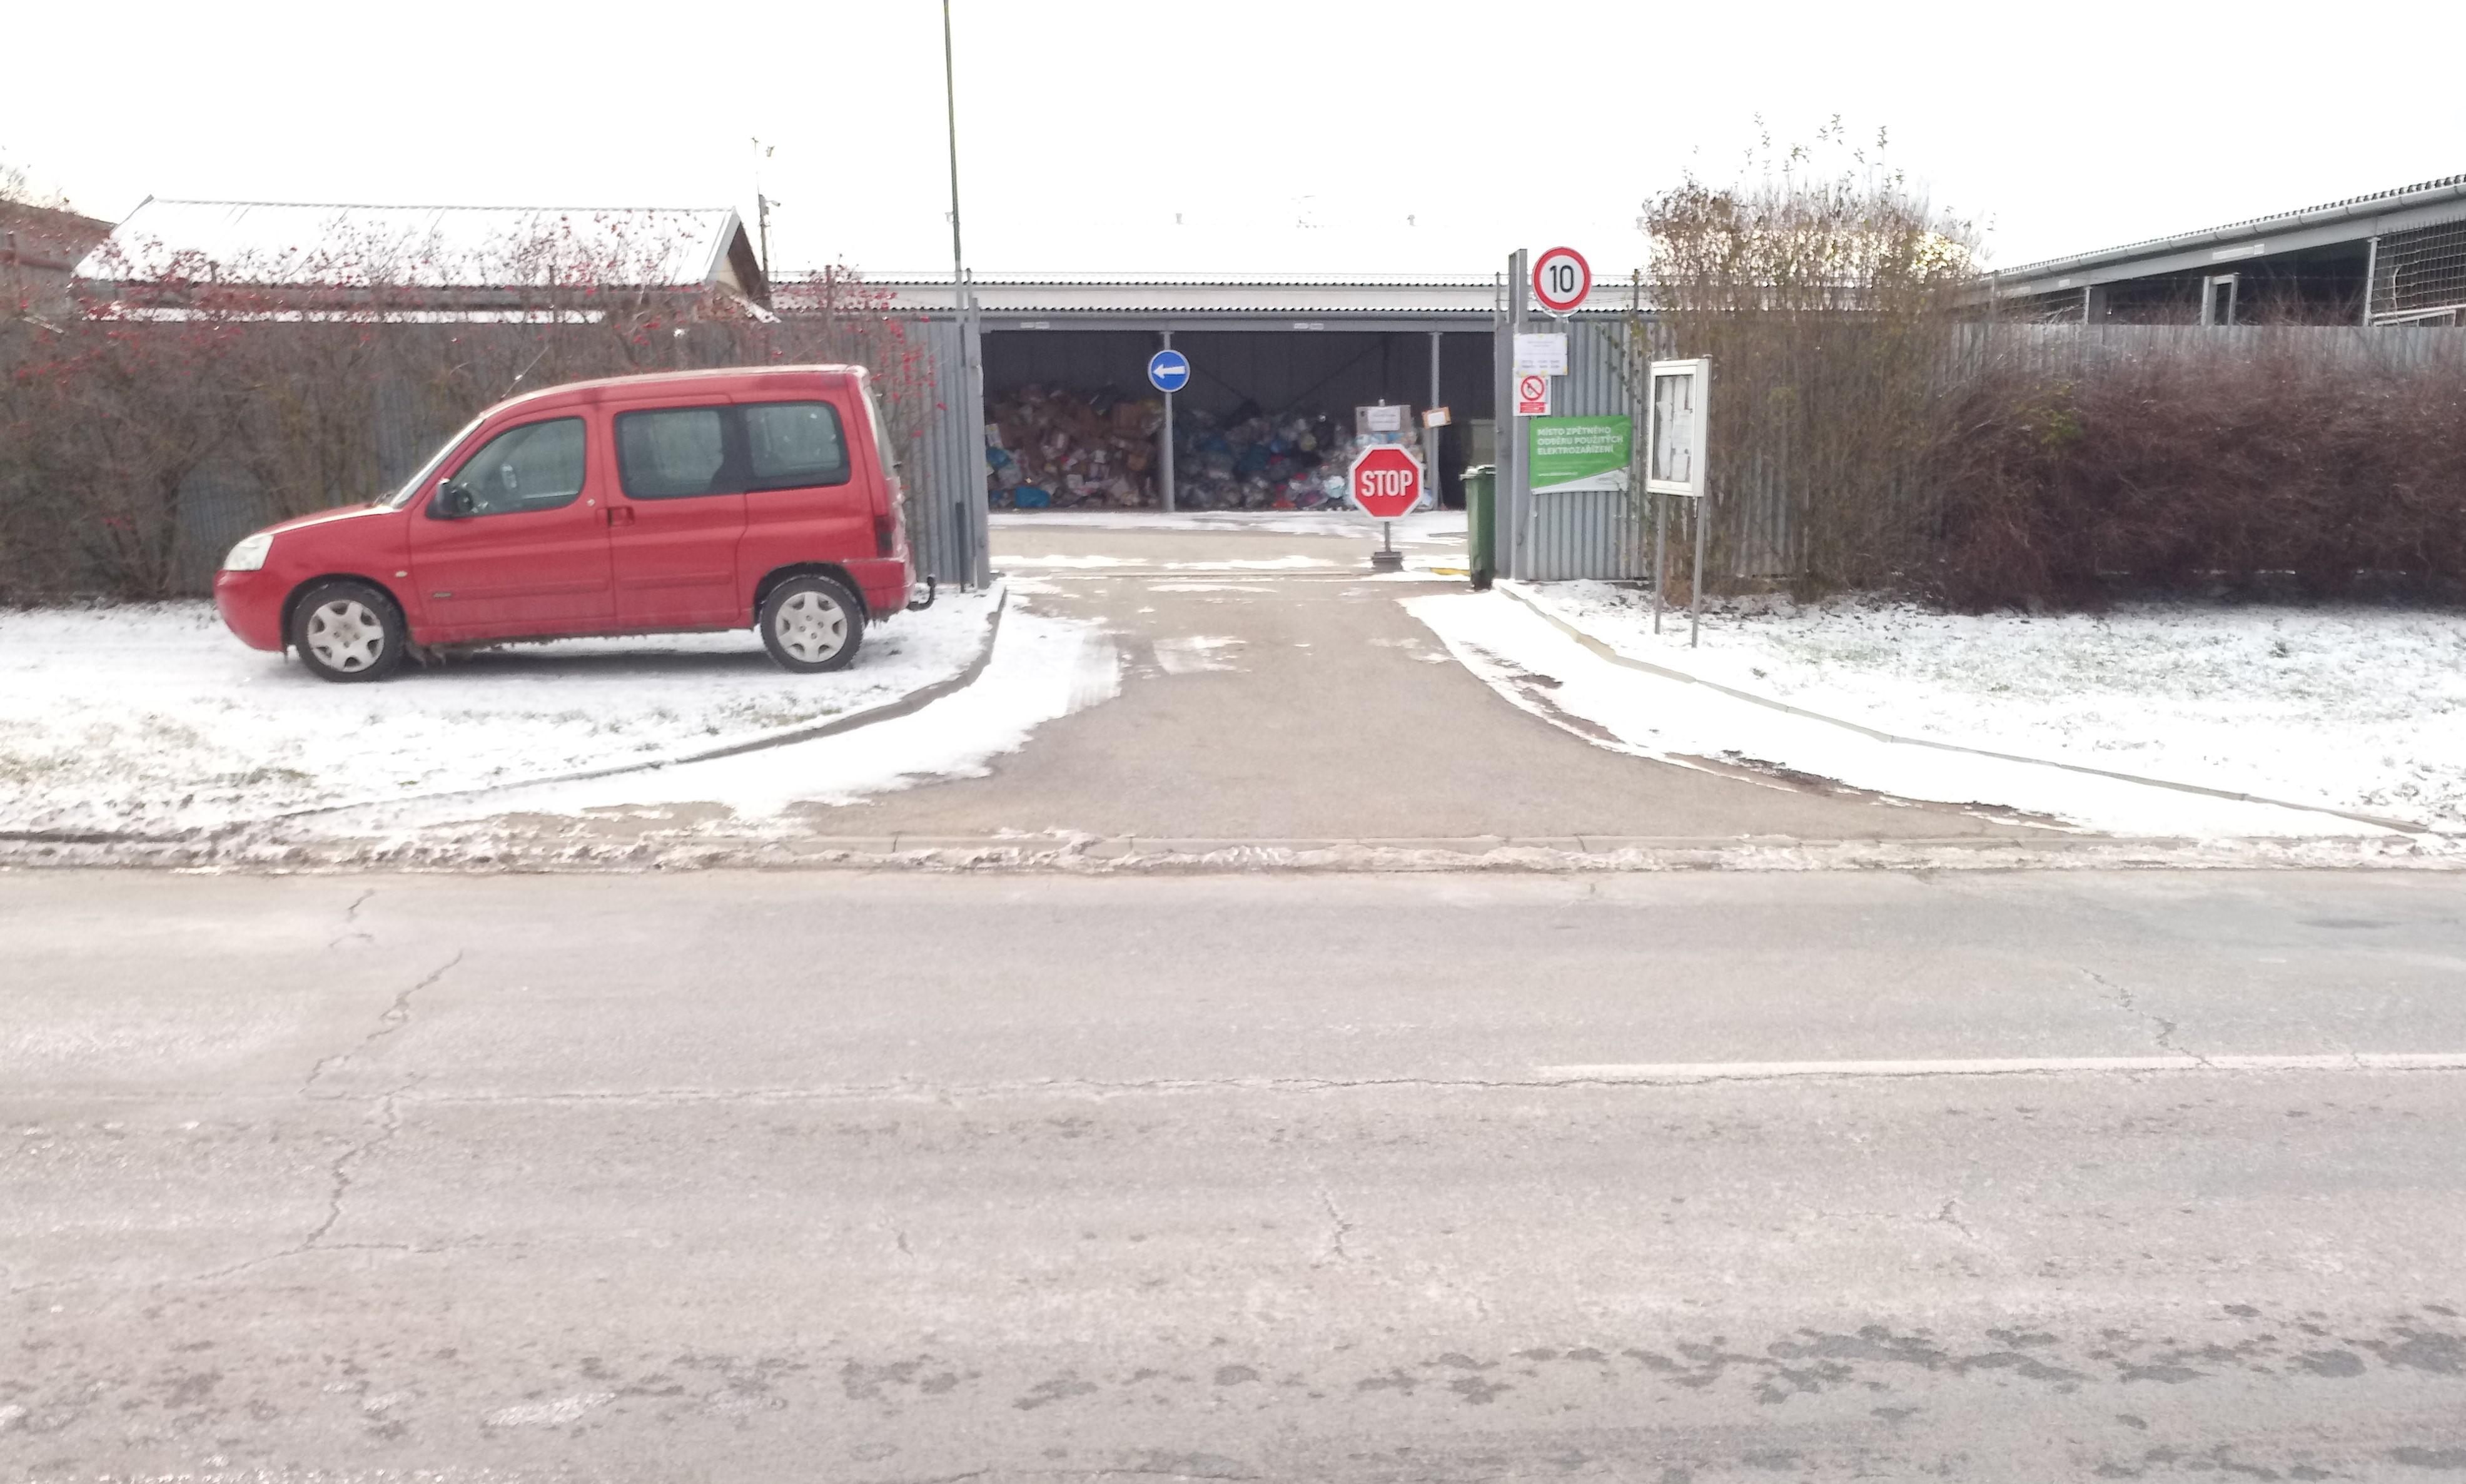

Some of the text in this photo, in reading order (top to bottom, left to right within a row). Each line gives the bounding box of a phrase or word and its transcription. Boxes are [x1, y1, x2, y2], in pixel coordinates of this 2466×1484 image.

[1549, 265, 1574, 293] 10
[1537, 426, 1612, 436] MÍSTO ZPĚTNÉHO
[1537, 437, 1573, 445] ODBĚRU
[1537, 445, 1614, 455] ELEKTROZAŘÍZENÍ
[1361, 470, 1413, 497] STOP
